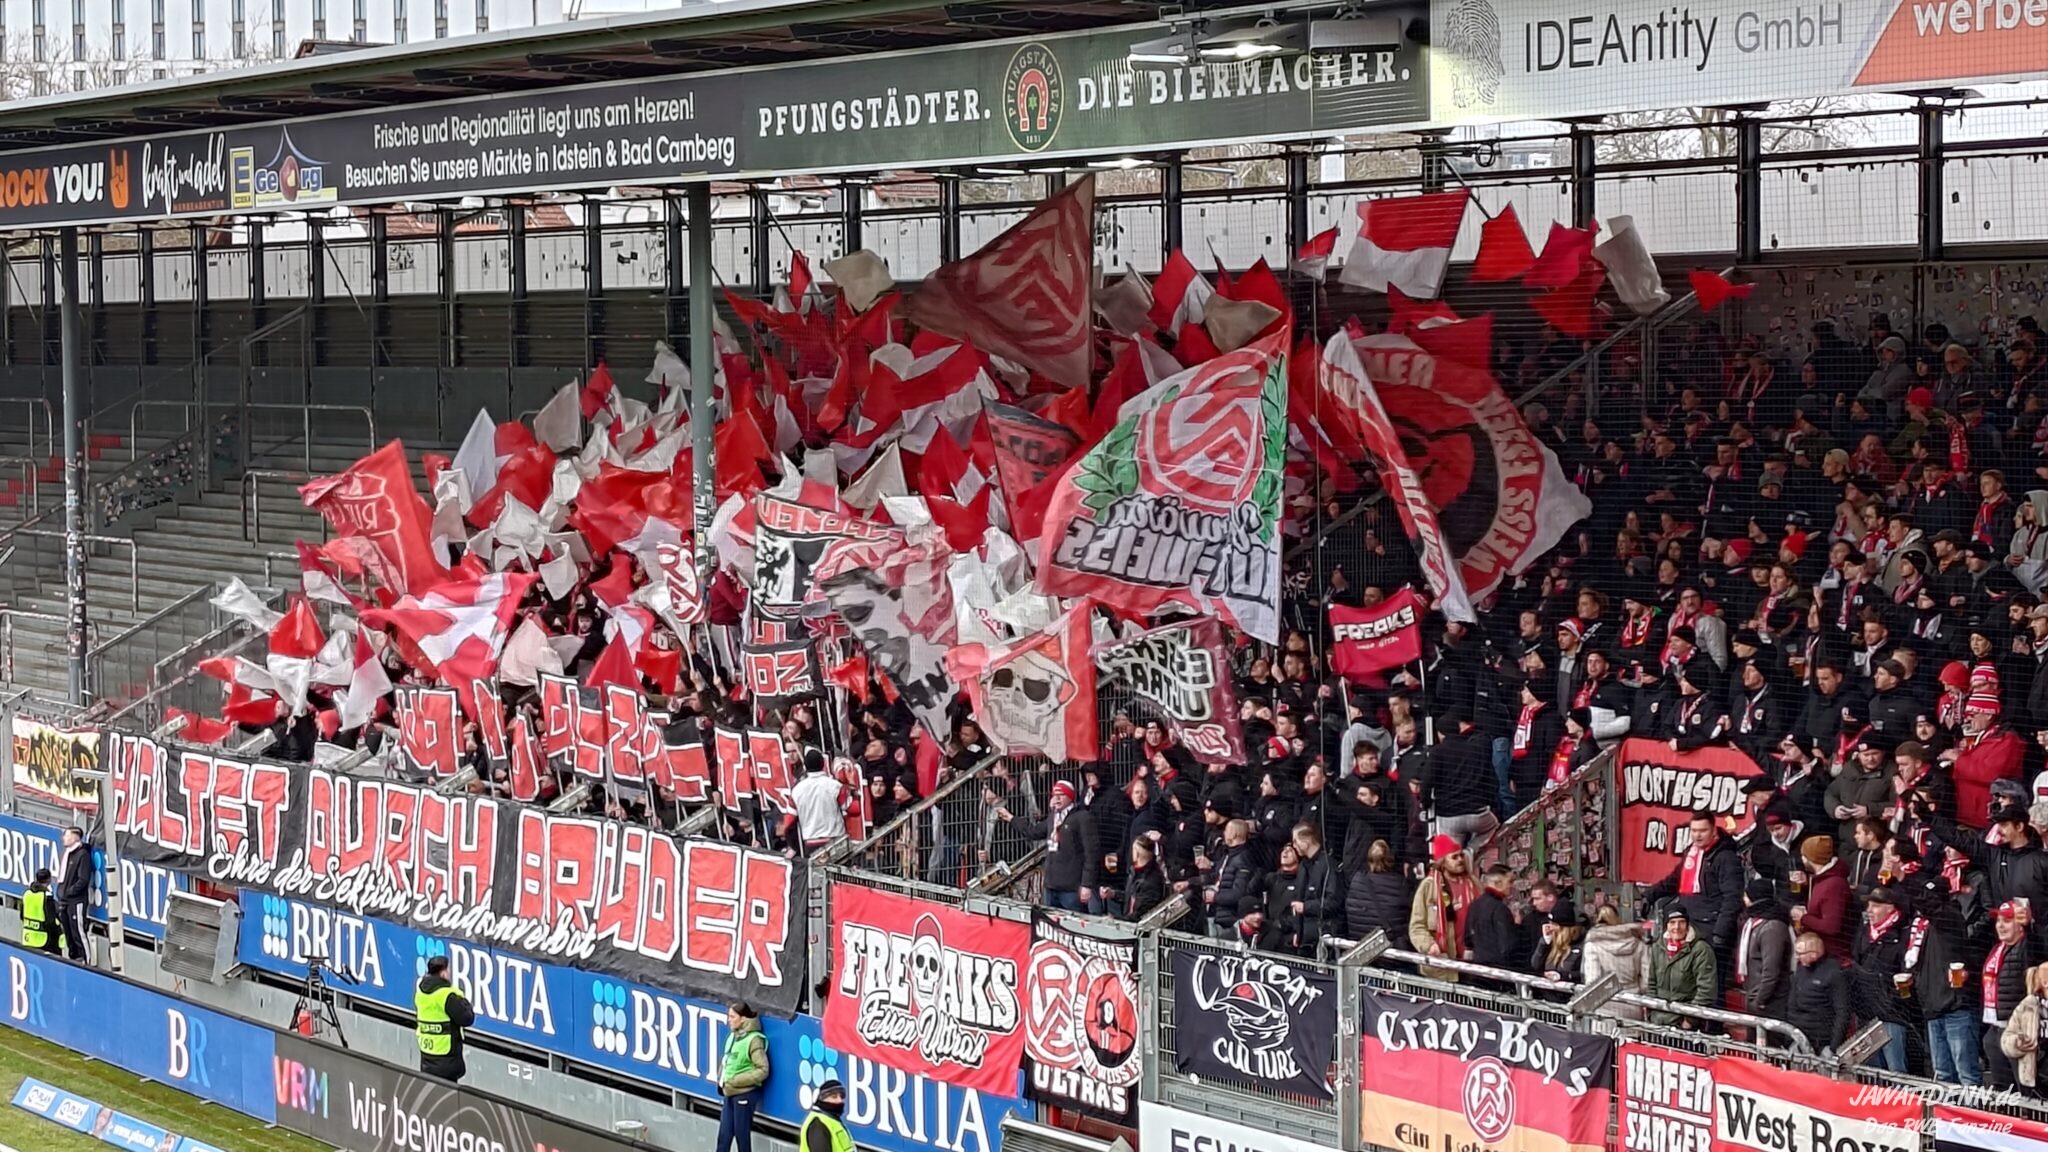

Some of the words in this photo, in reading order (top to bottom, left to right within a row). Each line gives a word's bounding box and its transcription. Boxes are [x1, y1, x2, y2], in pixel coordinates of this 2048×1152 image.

[1525, 7, 1718, 72] IDEAntity
[1734, 3, 1843, 54] GmbH
[1913, 0, 2048, 37] werbe
[1078, 73, 1134, 111] DIE
[1149, 51, 1411, 104] BIERMACHER.
[374, 121, 419, 149] Frische
[422, 118, 449, 145] und
[451, 110, 536, 147] Regionalität
[538, 105, 572, 138] liegt
[574, 107, 601, 128] uns
[604, 104, 631, 126] am
[634, 91, 695, 123] Herzen!
[758, 87, 991, 137] PFUNGSTÄDTER.
[53, 161, 105, 204] YOU!
[192, 132, 226, 197] adel
[345, 160, 408, 189] Besuchen
[410, 157, 431, 184] Sie
[432, 159, 479, 182] unsere
[481, 144, 533, 176] Märkte
[535, 149, 549, 173] in
[552, 140, 602, 169] Idstein
[605, 143, 618, 166] &
[620, 137, 653, 165] Bad
[655, 132, 736, 167] Camberg
[1333, 604, 1416, 642] FREAKS
[1623, 764, 1751, 815] NORTHSIDE
[0, 827, 60, 887] BRITA
[109, 731, 291, 869] HALTET
[304, 769, 498, 907] DURCH
[513, 809, 793, 987] BRÜDER
[208, 832, 270, 880] Ehre
[273, 847, 316, 896] der
[105, 856, 178, 926] RITA
[291, 902, 385, 988] BRITA
[9, 955, 48, 1029] BR
[448, 943, 556, 1036] BRITA
[841, 922, 1019, 1034] FREAKS
[167, 1008, 211, 1089] BR
[631, 989, 730, 1084] BRIT
[858, 991, 919, 1050] Essen
[918, 1004, 989, 1069] Ultras
[1213, 1037, 1302, 1081] CULTURE
[1376, 1010, 1592, 1097] Crazy-Boy's
[273, 1055, 329, 1119] VRM
[349, 1081, 387, 1138] Wir
[1033, 1060, 1127, 1114] ULTRAS
[1625, 1054, 1714, 1113] HAFEN
[1395, 1122, 1430, 1150] Ein
[1719, 1091, 1797, 1151] West
